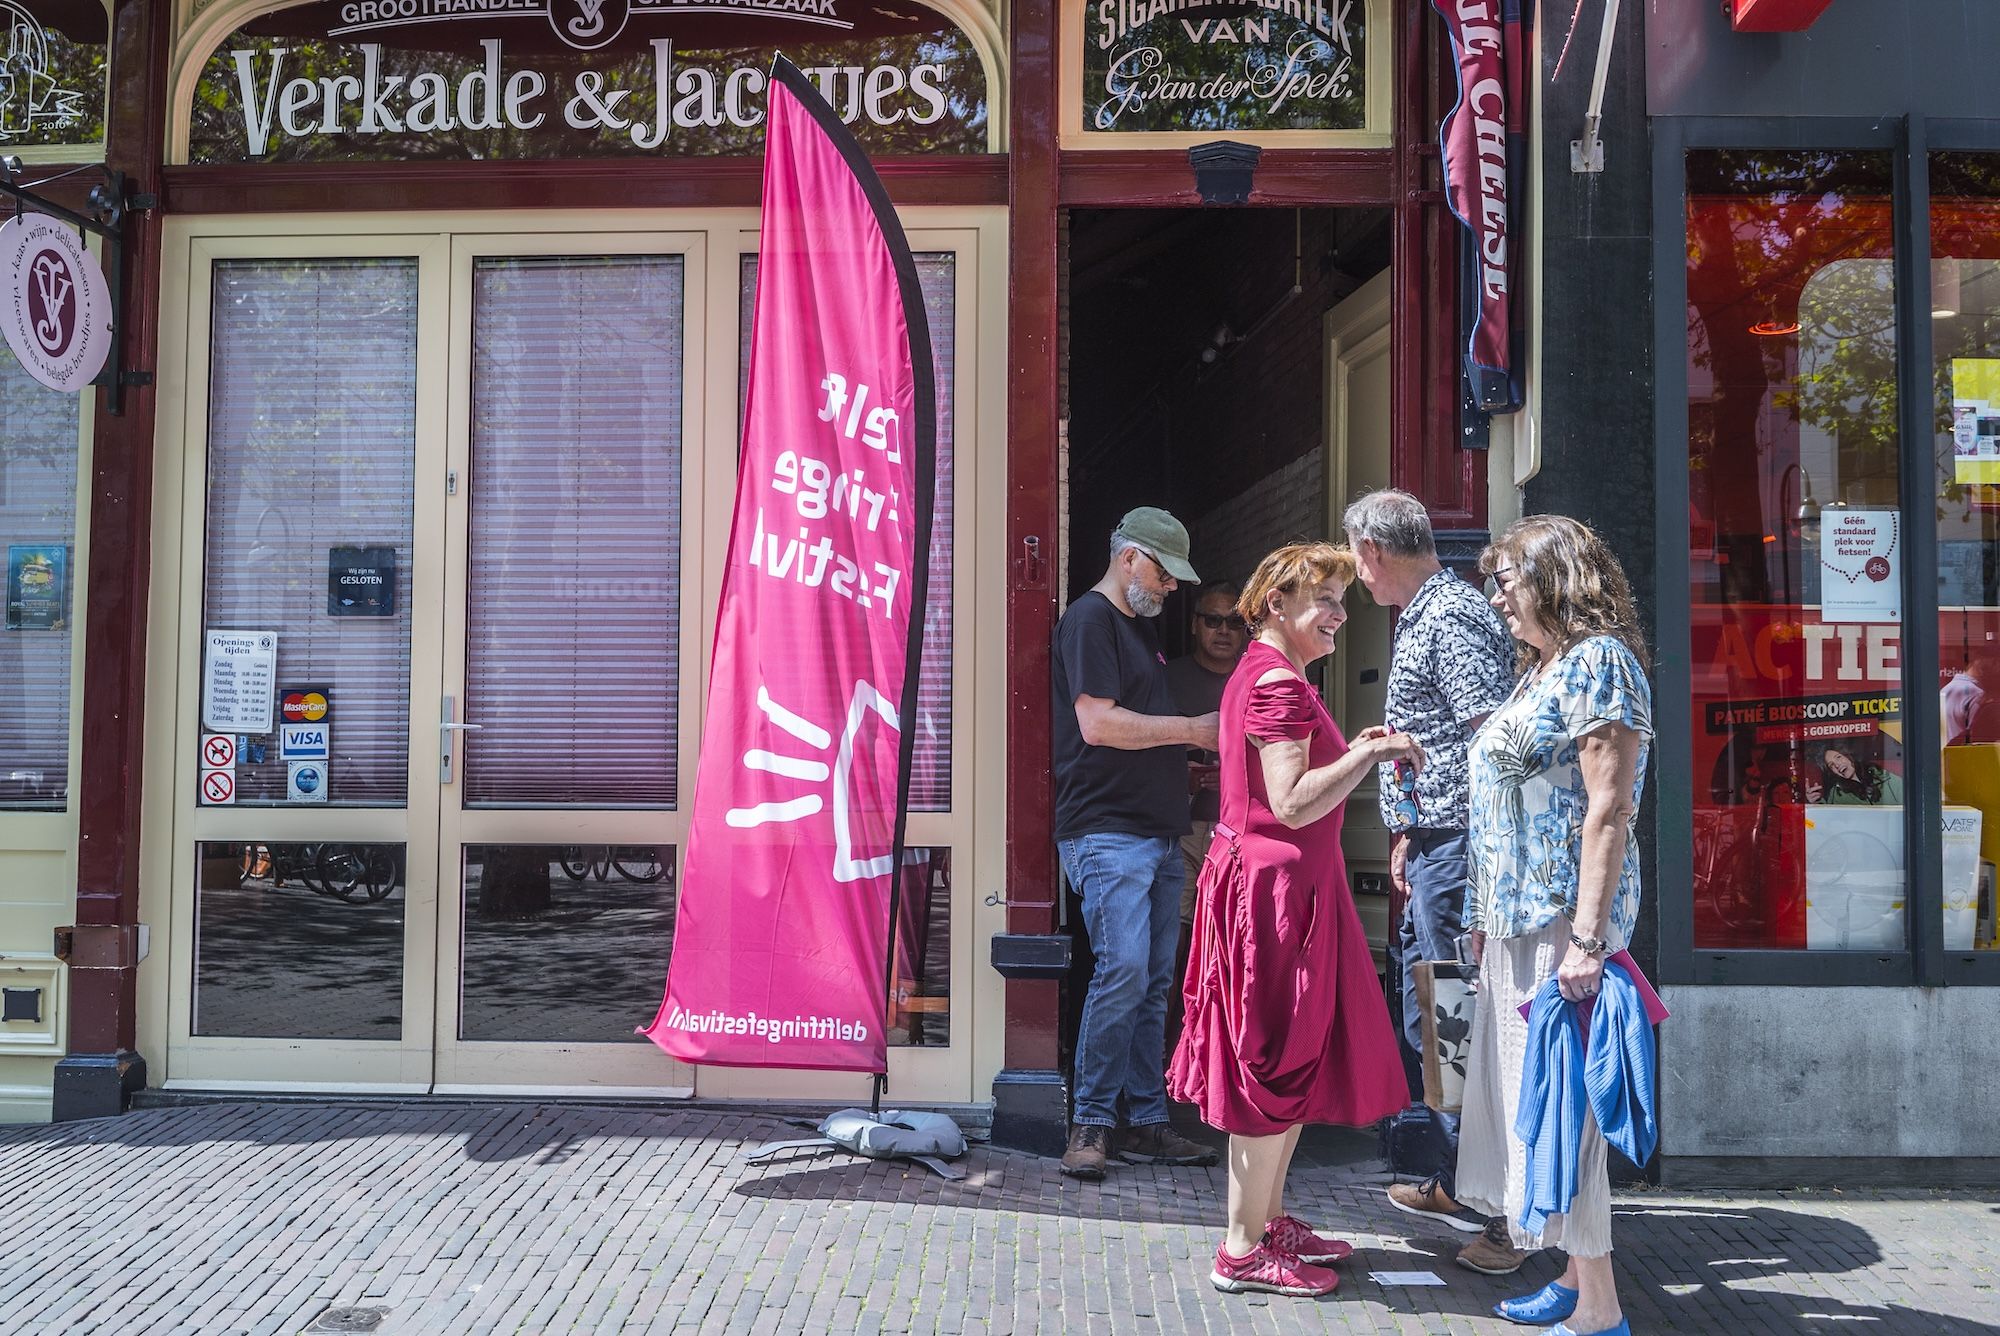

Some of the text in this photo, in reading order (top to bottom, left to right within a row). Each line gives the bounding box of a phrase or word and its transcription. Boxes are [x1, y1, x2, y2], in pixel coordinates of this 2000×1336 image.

[1181, 18, 1270, 43] VAN
[231, 38, 948, 156] Verkade & Jacues
[1470, 77, 1508, 300] CHEESE
[13, 224, 91, 385] kaas wijn delicatessen broodjes belegde vleeswaren
[1844, 516, 1865, 524] Géén
[1833, 527, 1876, 535] standaard
[1835, 538, 1853, 547] plek
[1838, 548, 1871, 556] fietsen!
[340, 576, 383, 584] GESLOTEN
[213, 637, 254, 647] Openings
[225, 647, 250, 655] tijden
[1709, 623, 1901, 681] ACTIE
[214, 661, 232, 669] Zondag
[212, 705, 231, 713] Vrijdag
[283, 703, 326, 711] MasterCard
[1715, 697, 1901, 725] PATHÉ BIOSCOOP TICKE
[212, 714, 234, 722] Zaterdag
[1810, 722, 1871, 737] GOEDKOPER!
[288, 732, 323, 744] VISA
